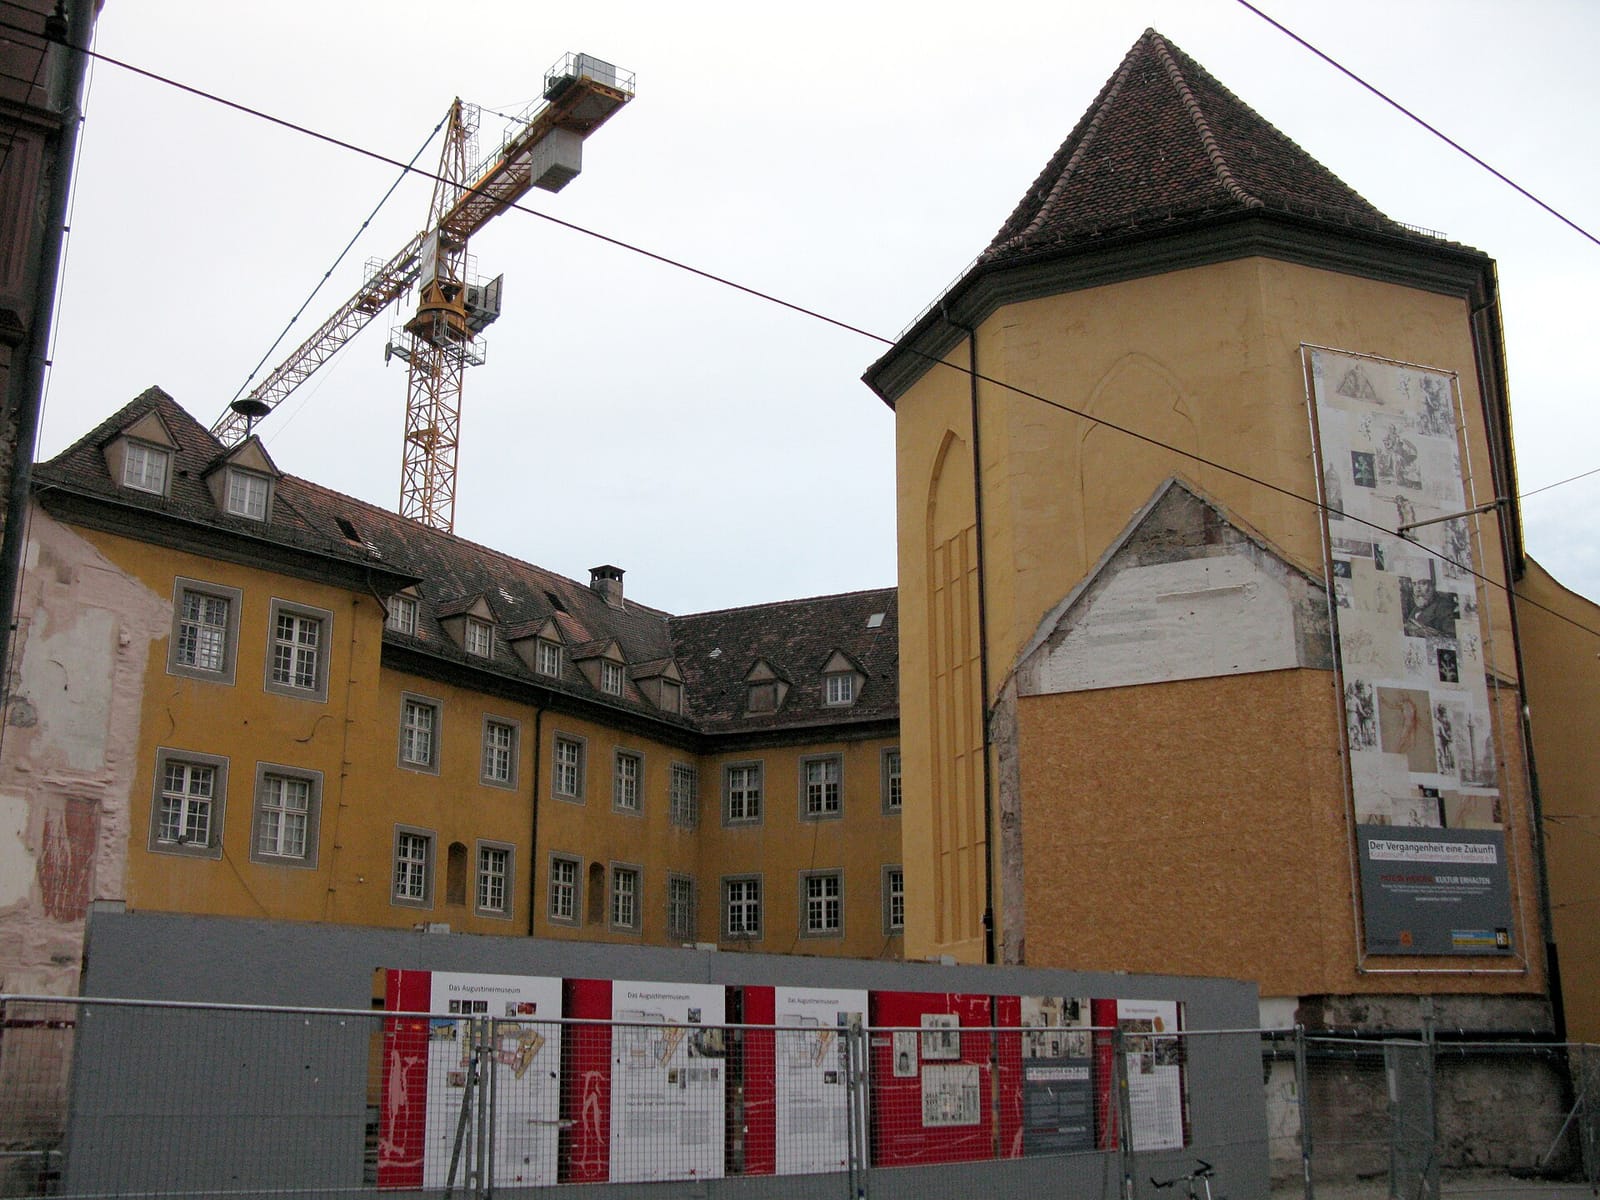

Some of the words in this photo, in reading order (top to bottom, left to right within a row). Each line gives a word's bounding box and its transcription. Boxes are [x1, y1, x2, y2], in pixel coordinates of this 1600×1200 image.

[1370, 840, 1384, 850] Der
[1386, 842, 1444, 854] Vergangenheit
[1446, 845, 1463, 853] eine
[1464, 844, 1494, 854] Zukunft
[448, 984, 461, 992] Das
[462, 984, 521, 994] Augustinermuseum
